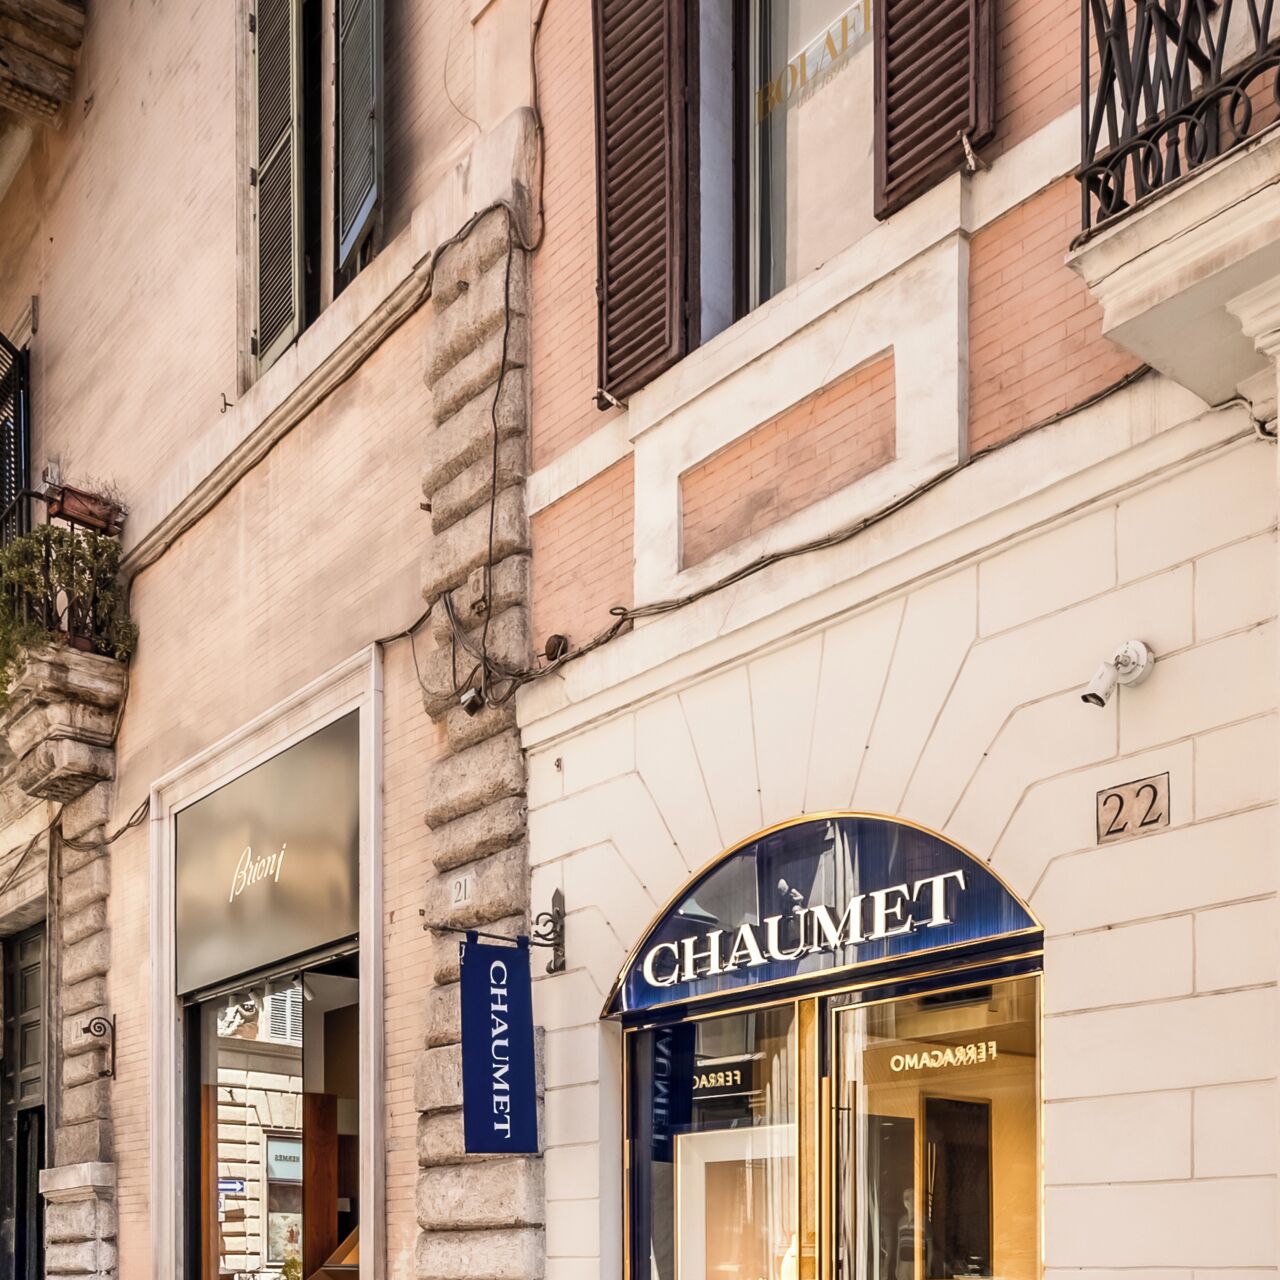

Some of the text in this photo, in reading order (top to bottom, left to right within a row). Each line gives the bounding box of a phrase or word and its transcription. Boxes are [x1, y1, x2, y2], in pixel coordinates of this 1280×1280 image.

[1103, 784, 1162, 836] 22
[229, 843, 287, 903] Brioni
[454, 879, 467, 903] 21
[642, 869, 966, 987] CHAUMET
[489, 959, 511, 1139] CHAUMET
